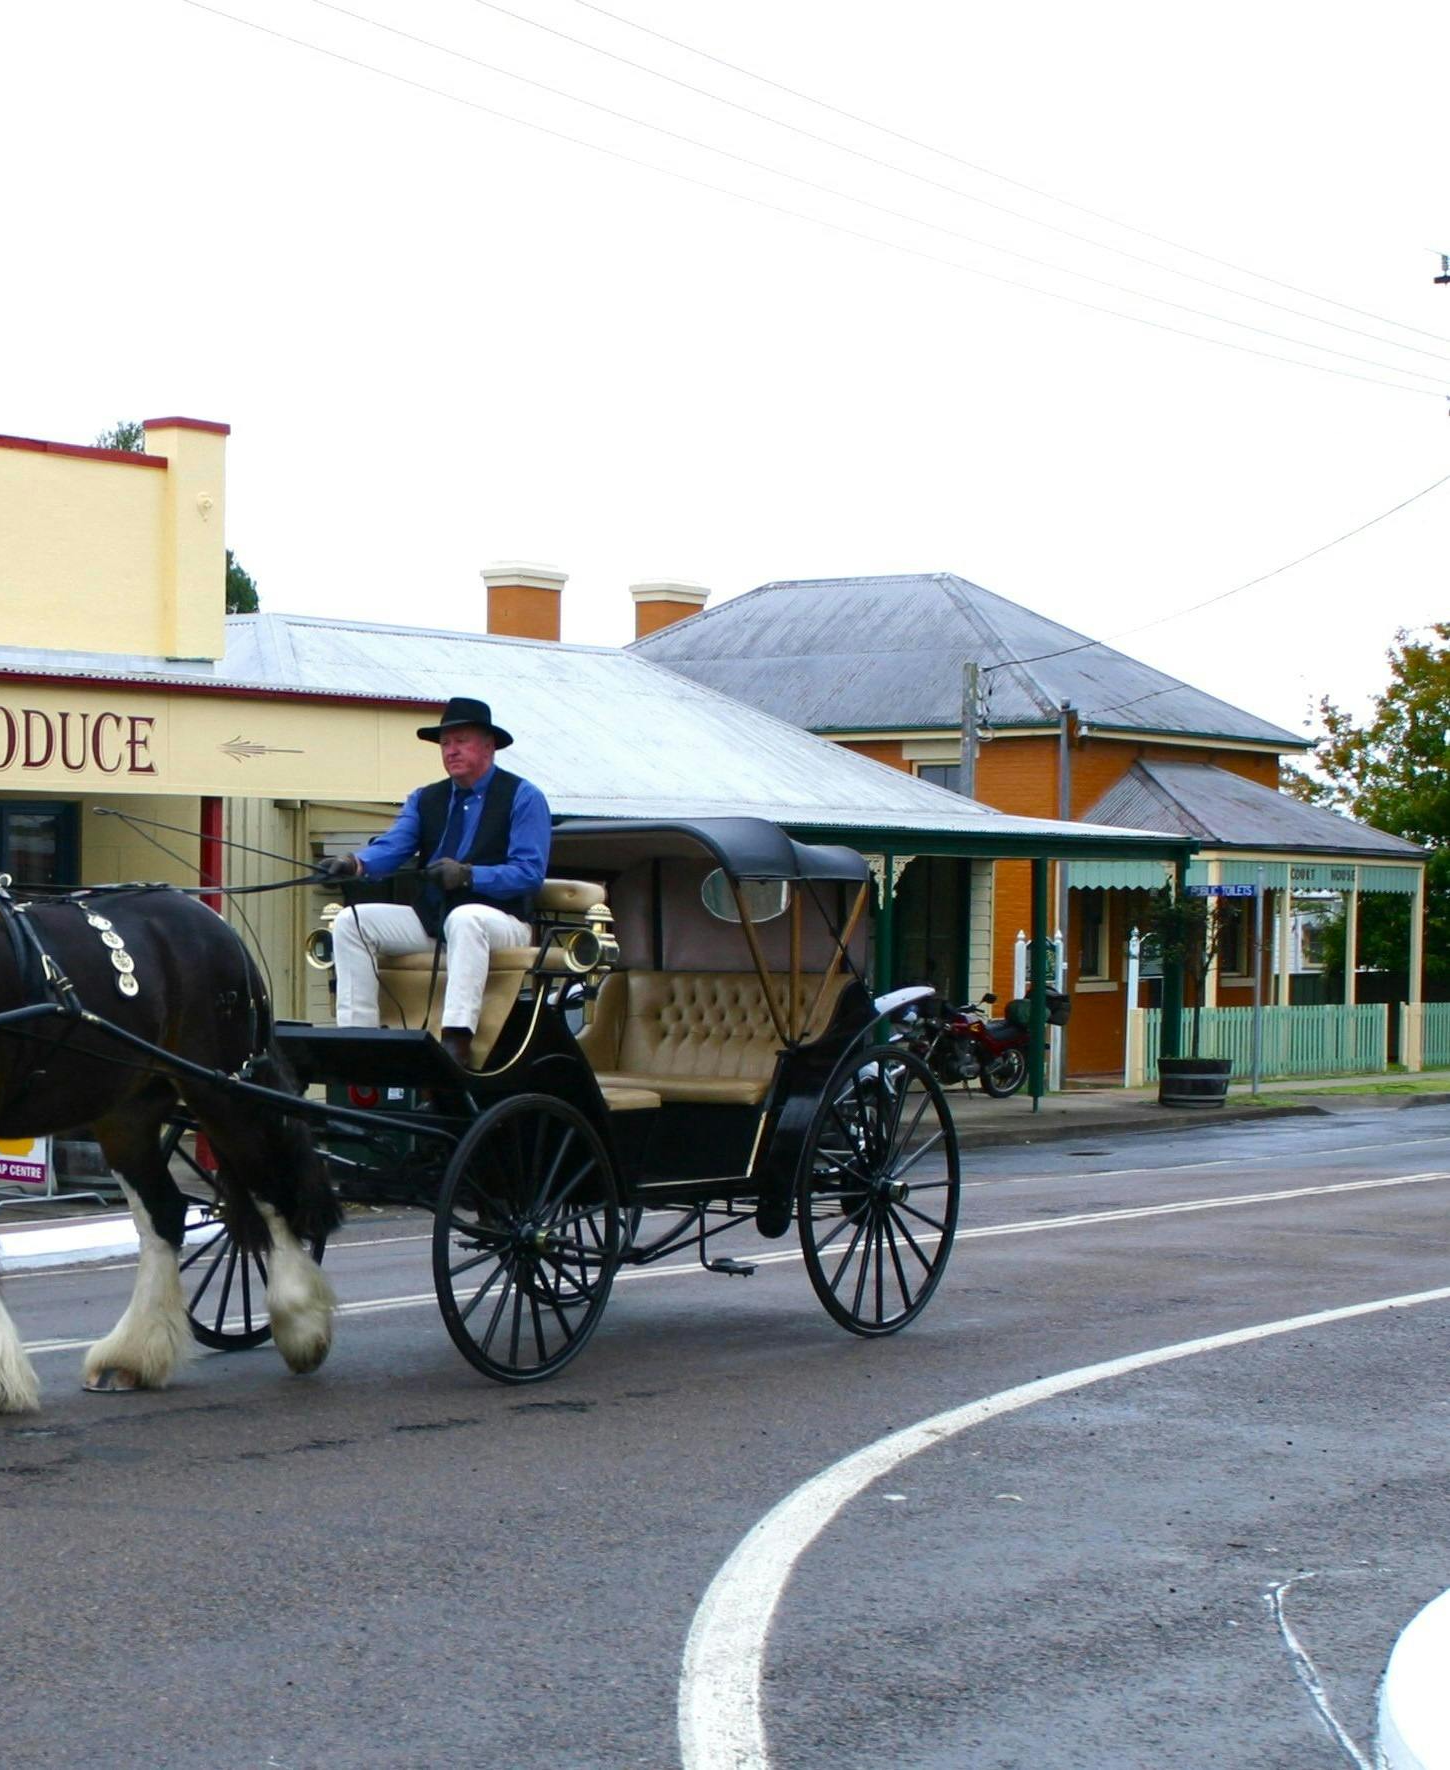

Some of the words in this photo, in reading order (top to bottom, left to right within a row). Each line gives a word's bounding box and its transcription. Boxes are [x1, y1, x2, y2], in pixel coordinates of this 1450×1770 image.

[1330, 869, 1356, 882] HOUSE
[1190, 886, 1220, 896] PUBLIC
[1222, 885, 1253, 897] TOILETS
[9, 1164, 42, 1179] CENTRE
